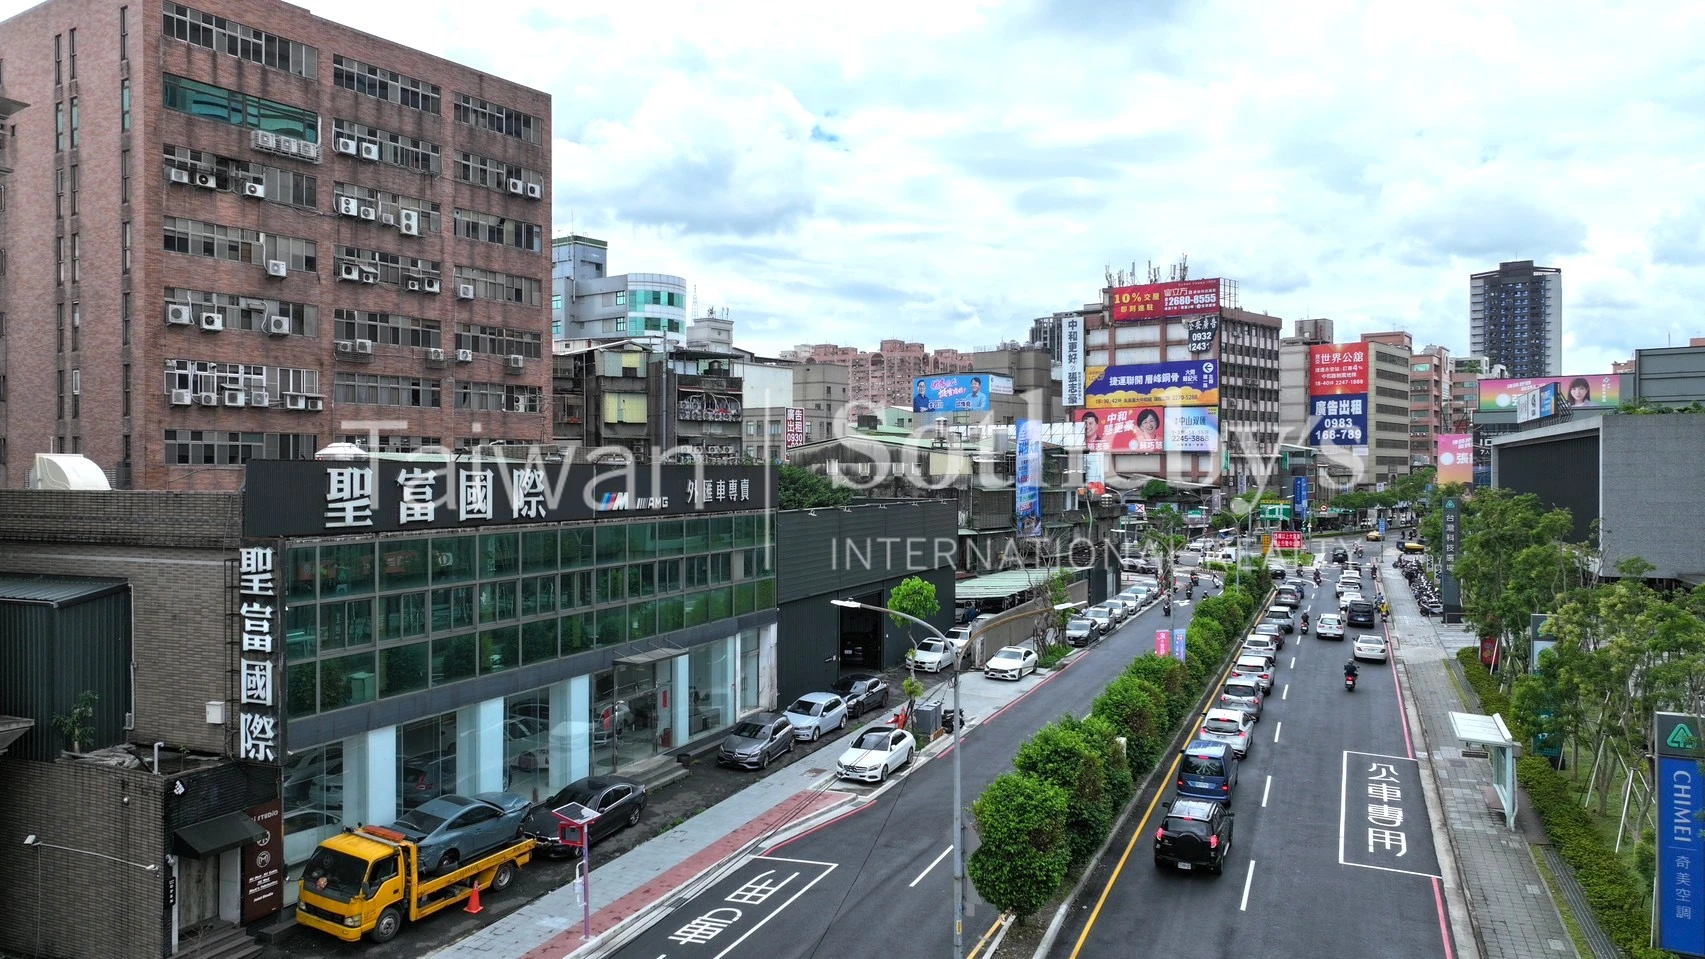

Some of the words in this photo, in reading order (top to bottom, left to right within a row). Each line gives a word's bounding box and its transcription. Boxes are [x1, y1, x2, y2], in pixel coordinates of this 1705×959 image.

[1114, 293, 1142, 304] 10%
[1168, 293, 1217, 306] 2680-8555
[1067, 319, 1078, 364] 中和更好
[1192, 331, 1212, 341] 0932
[1067, 371, 1078, 405] 張志豪
[1107, 411, 1128, 424] 中和
[1315, 399, 1363, 416] 廣告出租
[1315, 429, 1362, 440] 168-789
[1324, 418, 1353, 428] 0983
[324, 466, 547, 529] 聖富國際
[685, 478, 750, 504] 外匯車專賣
[239, 547, 276, 761] 聖富國際
[1367, 762, 1407, 857] 公車專用
[1673, 770, 1692, 842] CHIMEI
[1675, 855, 1692, 920] 奇美空調
